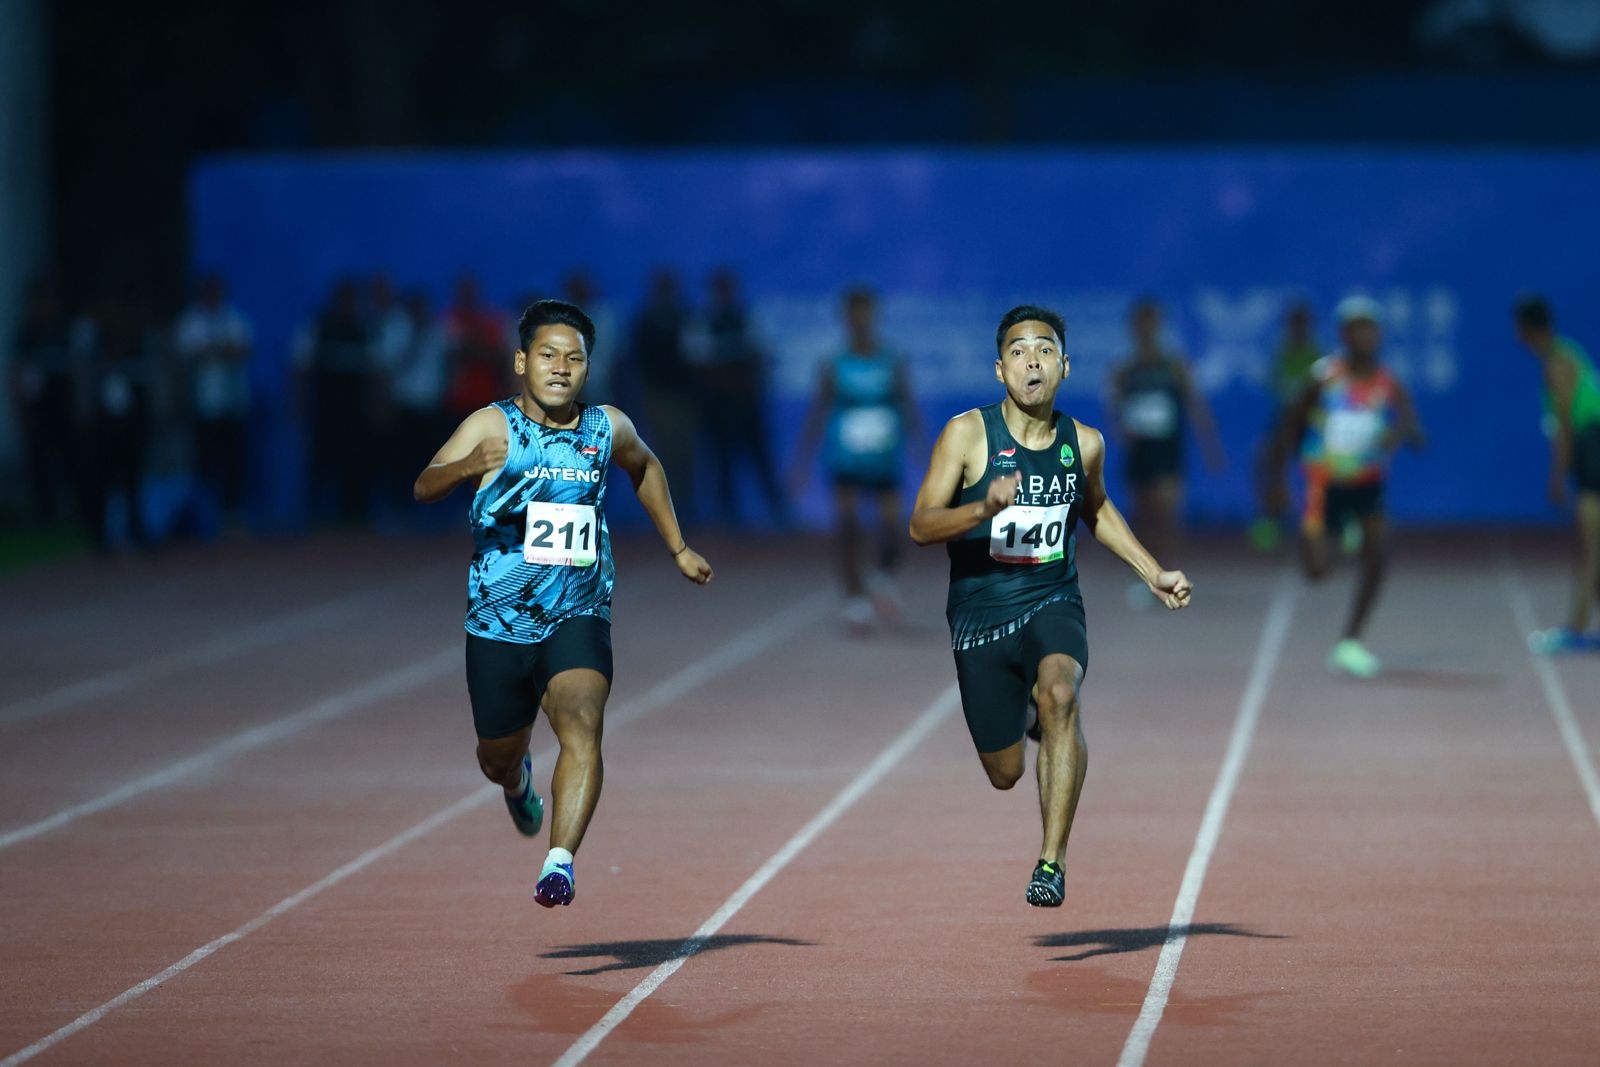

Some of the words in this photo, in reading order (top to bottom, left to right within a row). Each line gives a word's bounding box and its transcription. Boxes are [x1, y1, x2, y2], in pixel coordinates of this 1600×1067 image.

[524, 466, 600, 483] JATENG
[1001, 473, 1077, 494] ABAR
[1014, 492, 1076, 505] HLETICS
[531, 519, 591, 551] 211
[1000, 520, 1063, 549] 140
